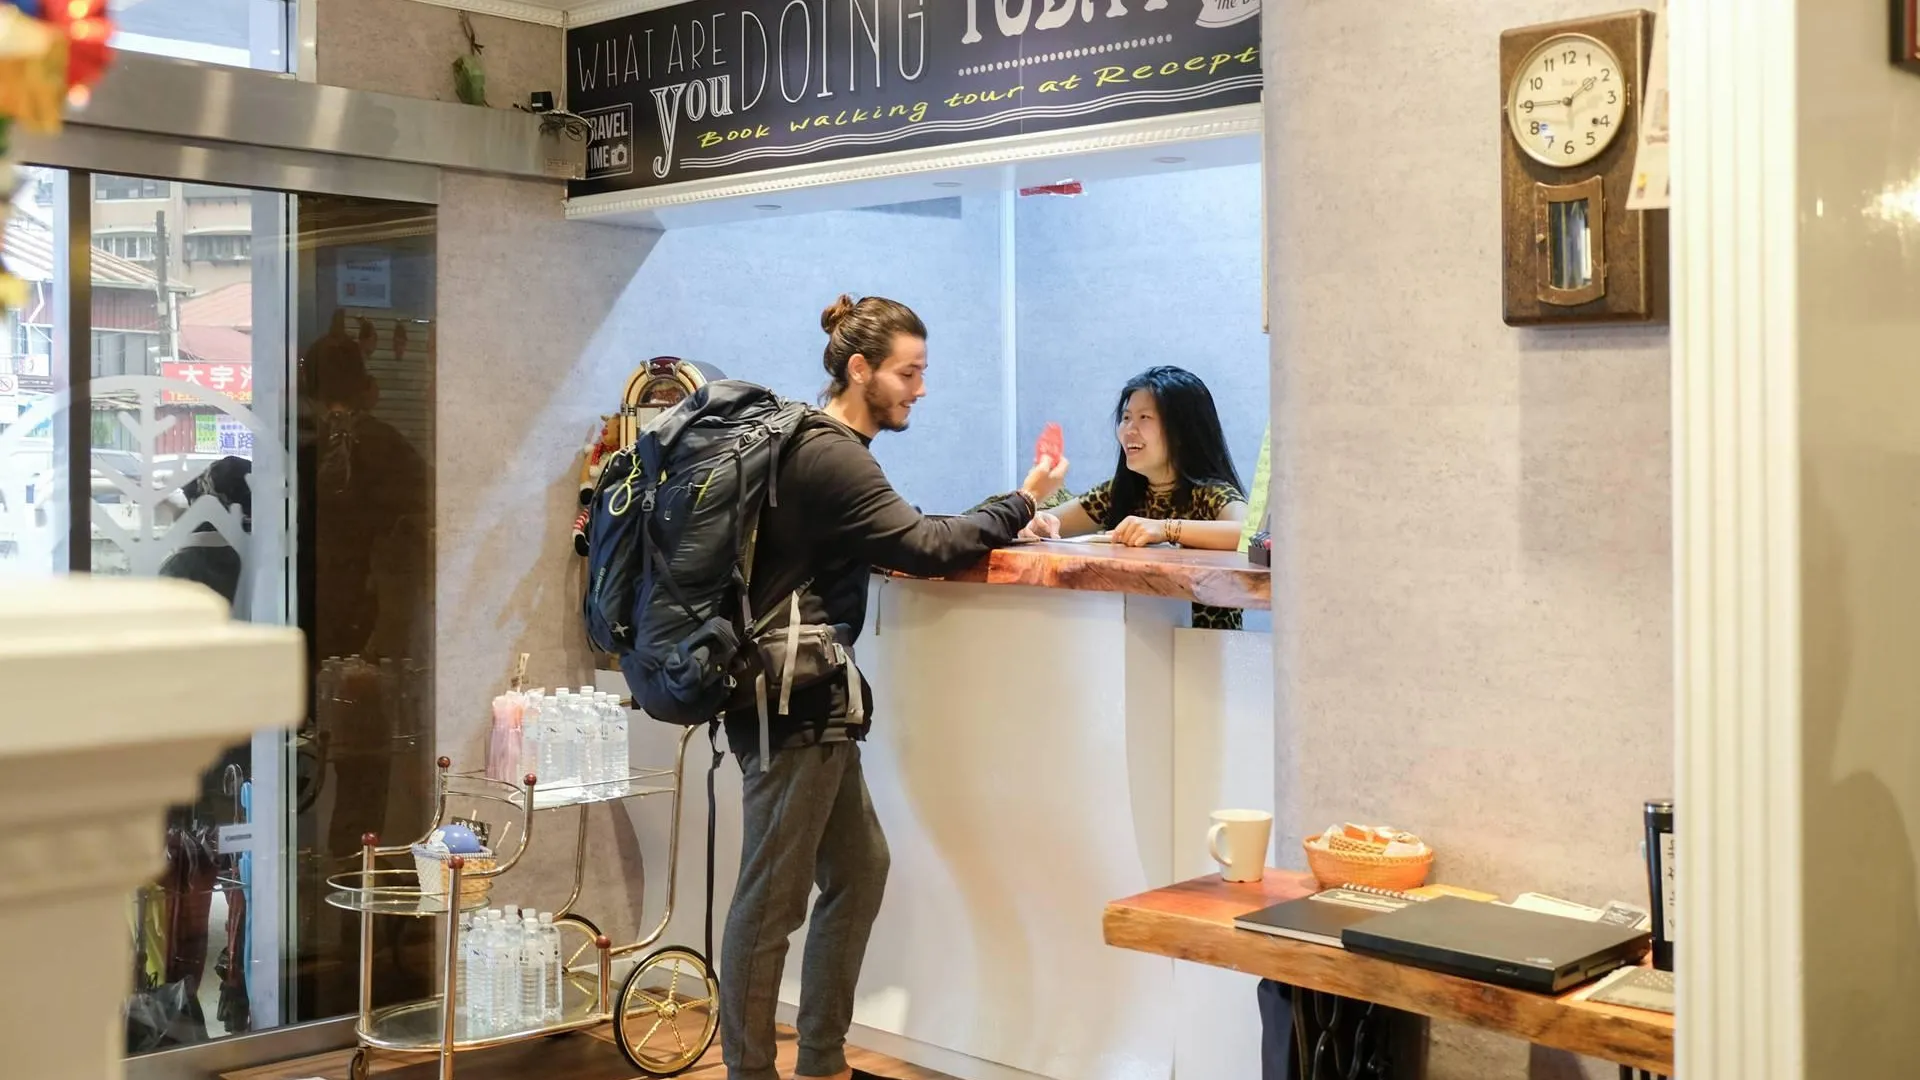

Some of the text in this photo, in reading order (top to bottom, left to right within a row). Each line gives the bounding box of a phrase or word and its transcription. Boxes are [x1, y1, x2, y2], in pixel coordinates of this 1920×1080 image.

[578, 12, 726, 92] WHAT ARE
[741, 0, 924, 111] DOING
[1562, 51, 1577, 65] 12
[1544, 58, 1555, 72] 11
[1586, 54, 1591, 67] 1
[1601, 68, 1610, 82] 2
[1530, 77, 1543, 91] 10
[1607, 90, 1617, 105] 3
[696, 124, 770, 149] Book
[790, 97, 927, 133] walking
[944, 84, 1025, 108] tour
[1038, 74, 1082, 92] at
[1524, 100, 1535, 113] 9
[588, 112, 628, 141] RAVEL
[650, 74, 733, 179] you
[1530, 121, 1540, 135] 8
[1600, 114, 1611, 128] 4
[1545, 135, 1555, 149] 7
[1586, 131, 1596, 146] 5
[1564, 140, 1575, 154] 6
[588, 145, 610, 170] IME
